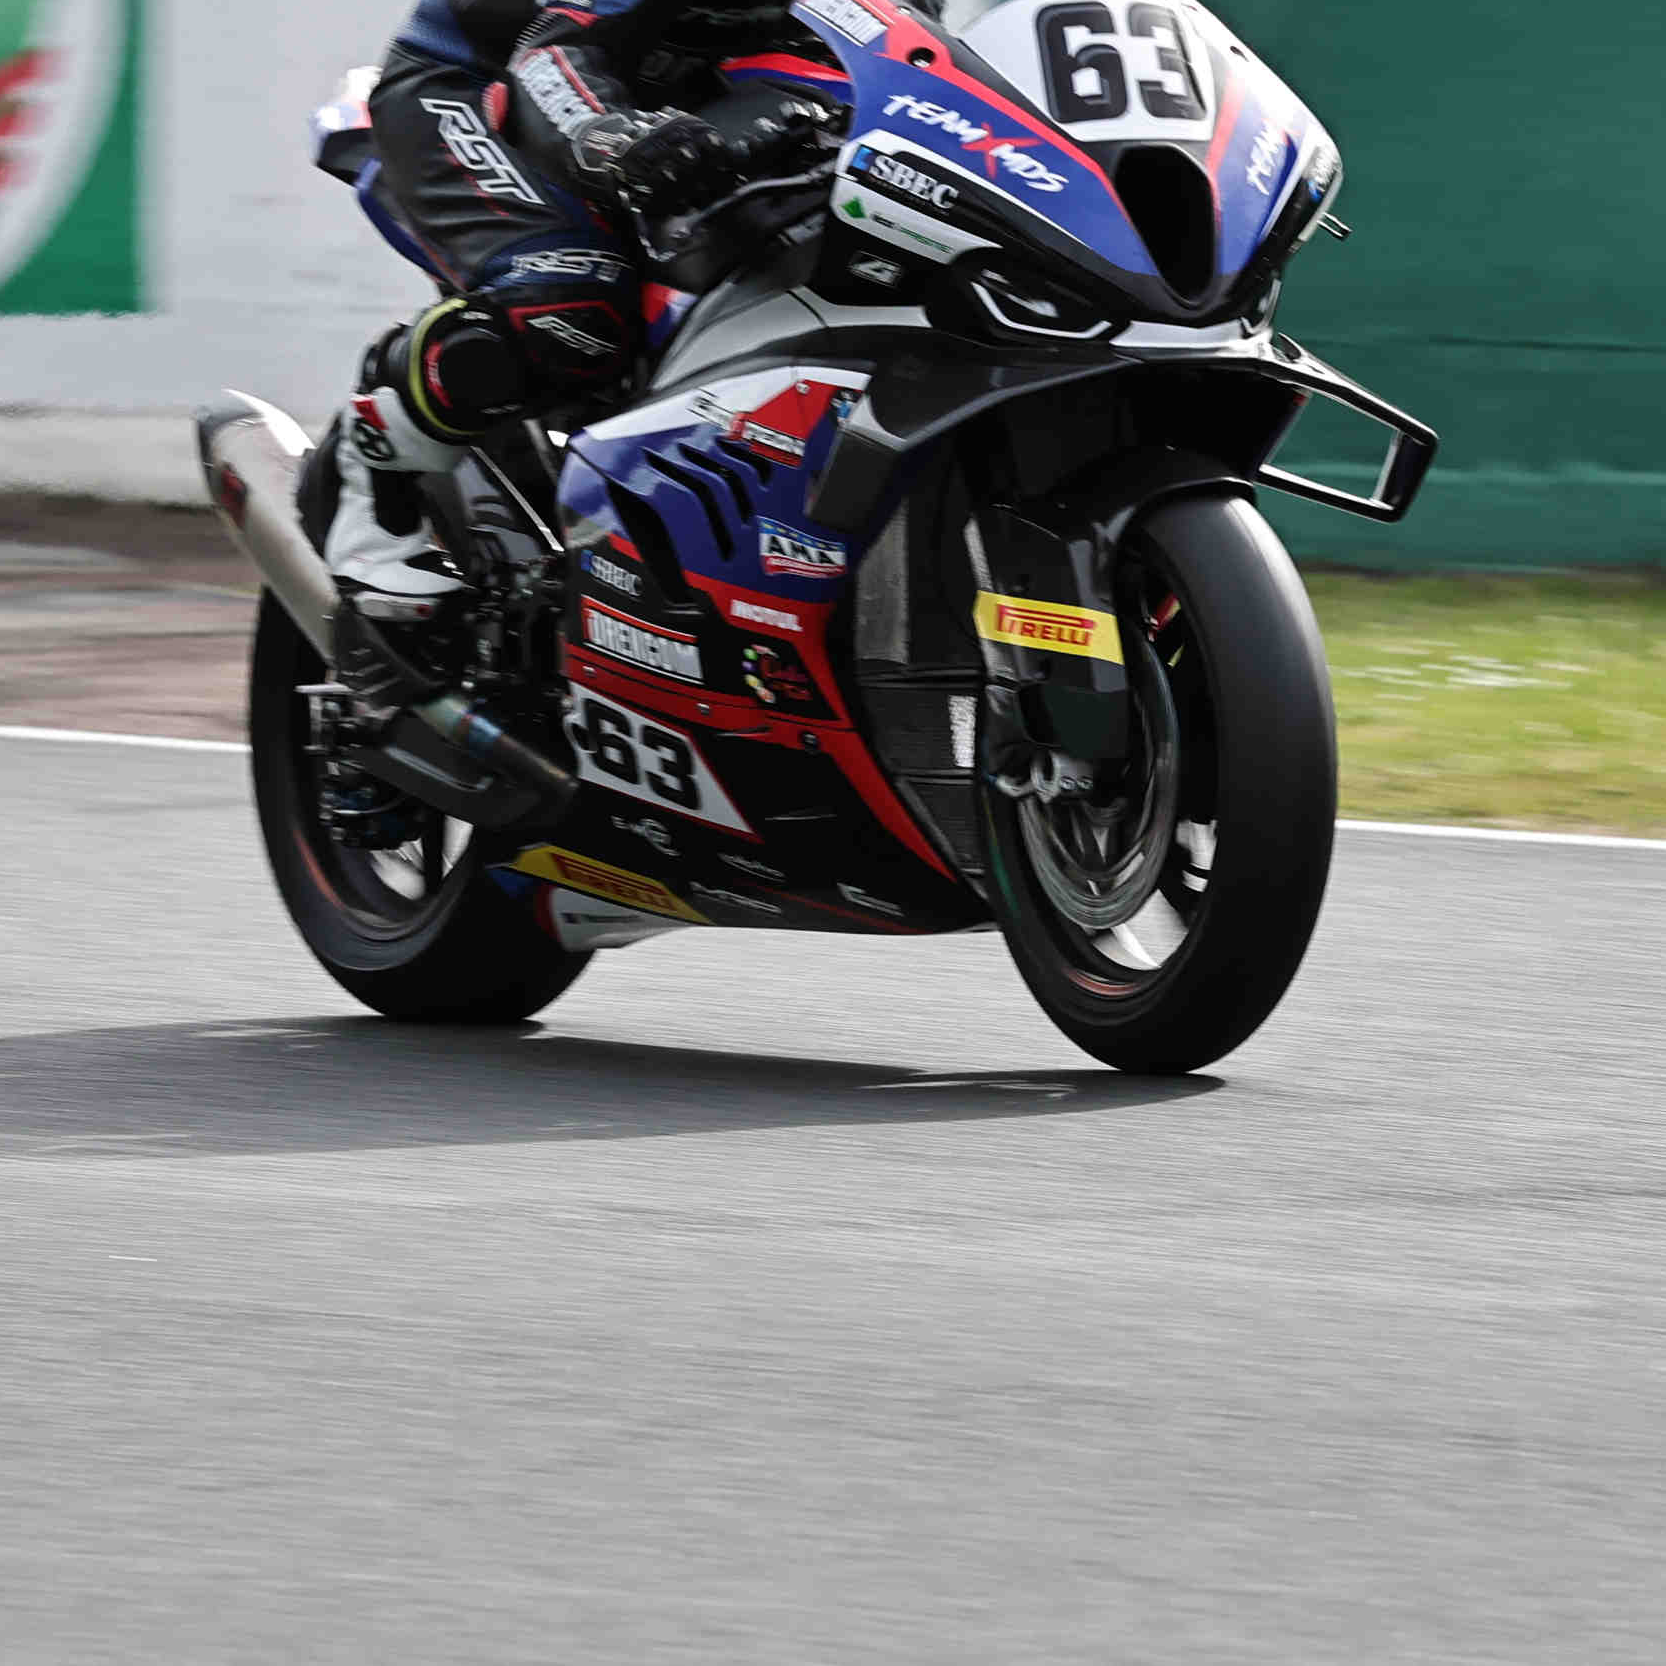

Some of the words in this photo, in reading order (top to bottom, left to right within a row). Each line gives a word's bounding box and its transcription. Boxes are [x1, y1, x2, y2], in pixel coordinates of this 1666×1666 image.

[1036, 1, 1208, 123] 63
[419, 97, 546, 205] RST
[868, 154, 959, 209] SBEC
[767, 535, 841, 565] AMA
[996, 603, 1098, 646] PIRELLI
[583, 698, 703, 810] 63
